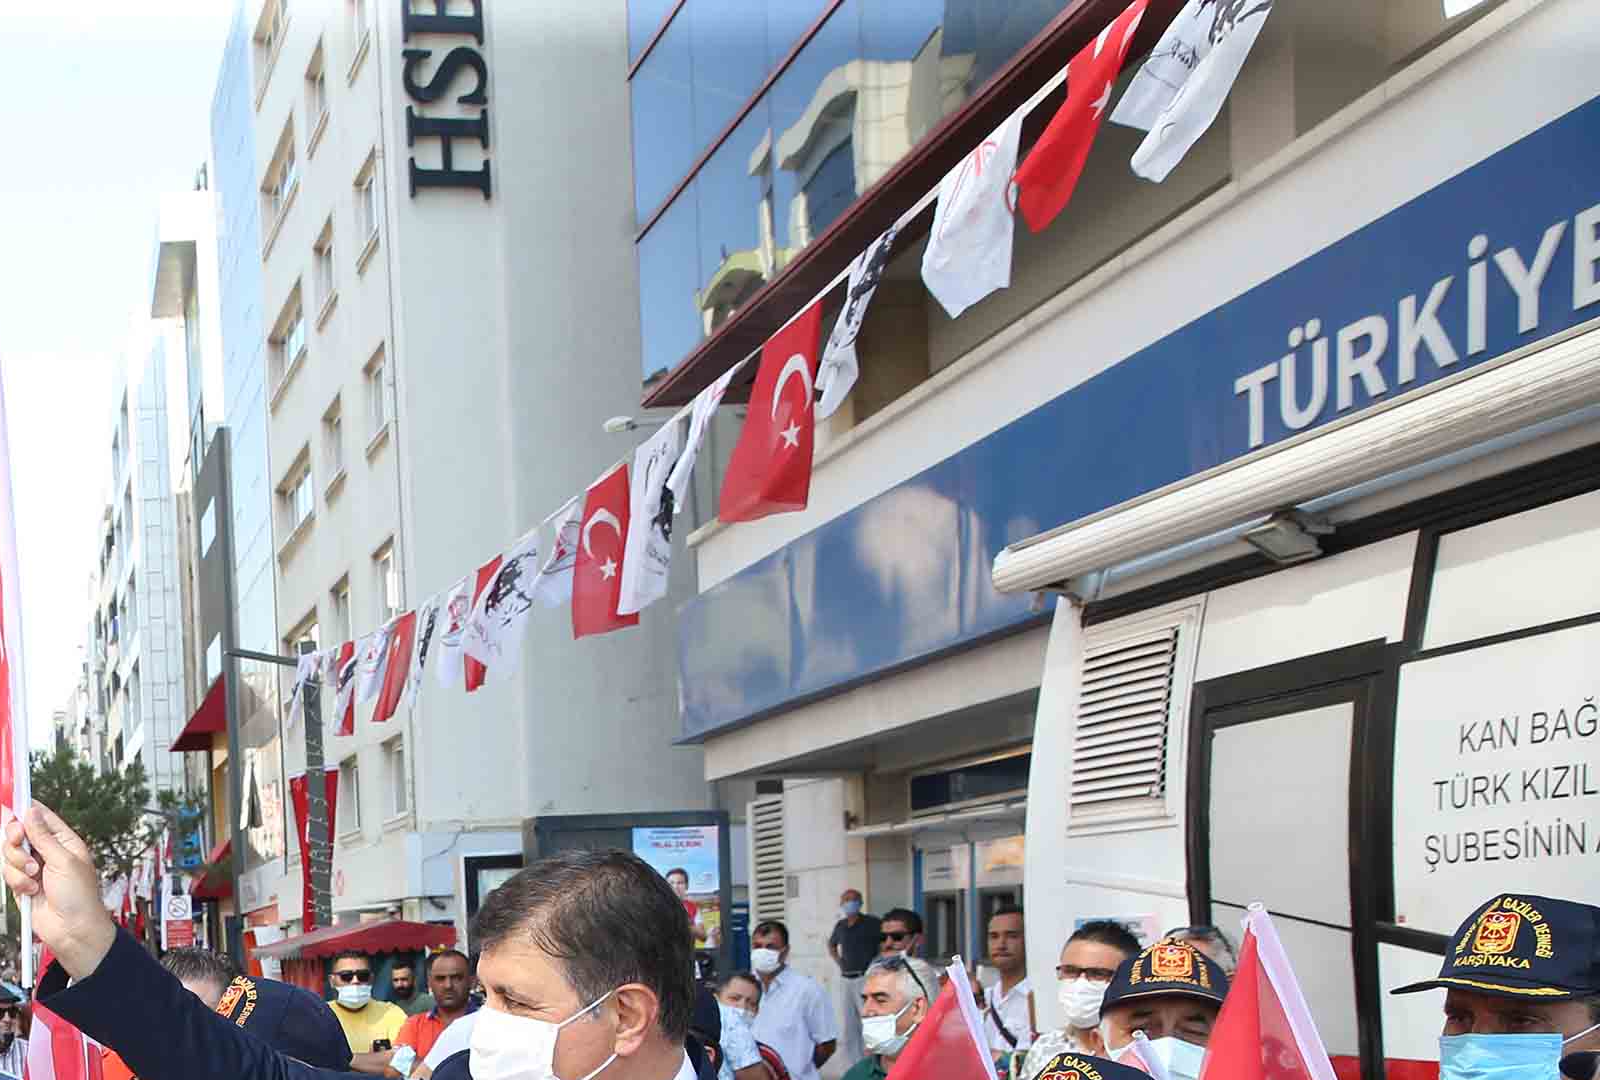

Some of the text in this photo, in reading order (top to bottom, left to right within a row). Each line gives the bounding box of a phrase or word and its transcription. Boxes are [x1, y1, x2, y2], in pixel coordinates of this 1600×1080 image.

[1459, 696, 1600, 754] KAN BAĞ
[1433, 771, 1511, 811] TÜRK
[1424, 817, 1587, 873] ŞUBESİNİN
[1503, 897, 1542, 924] GAZİLER
[1453, 952, 1531, 969] KARŞIYAKA
